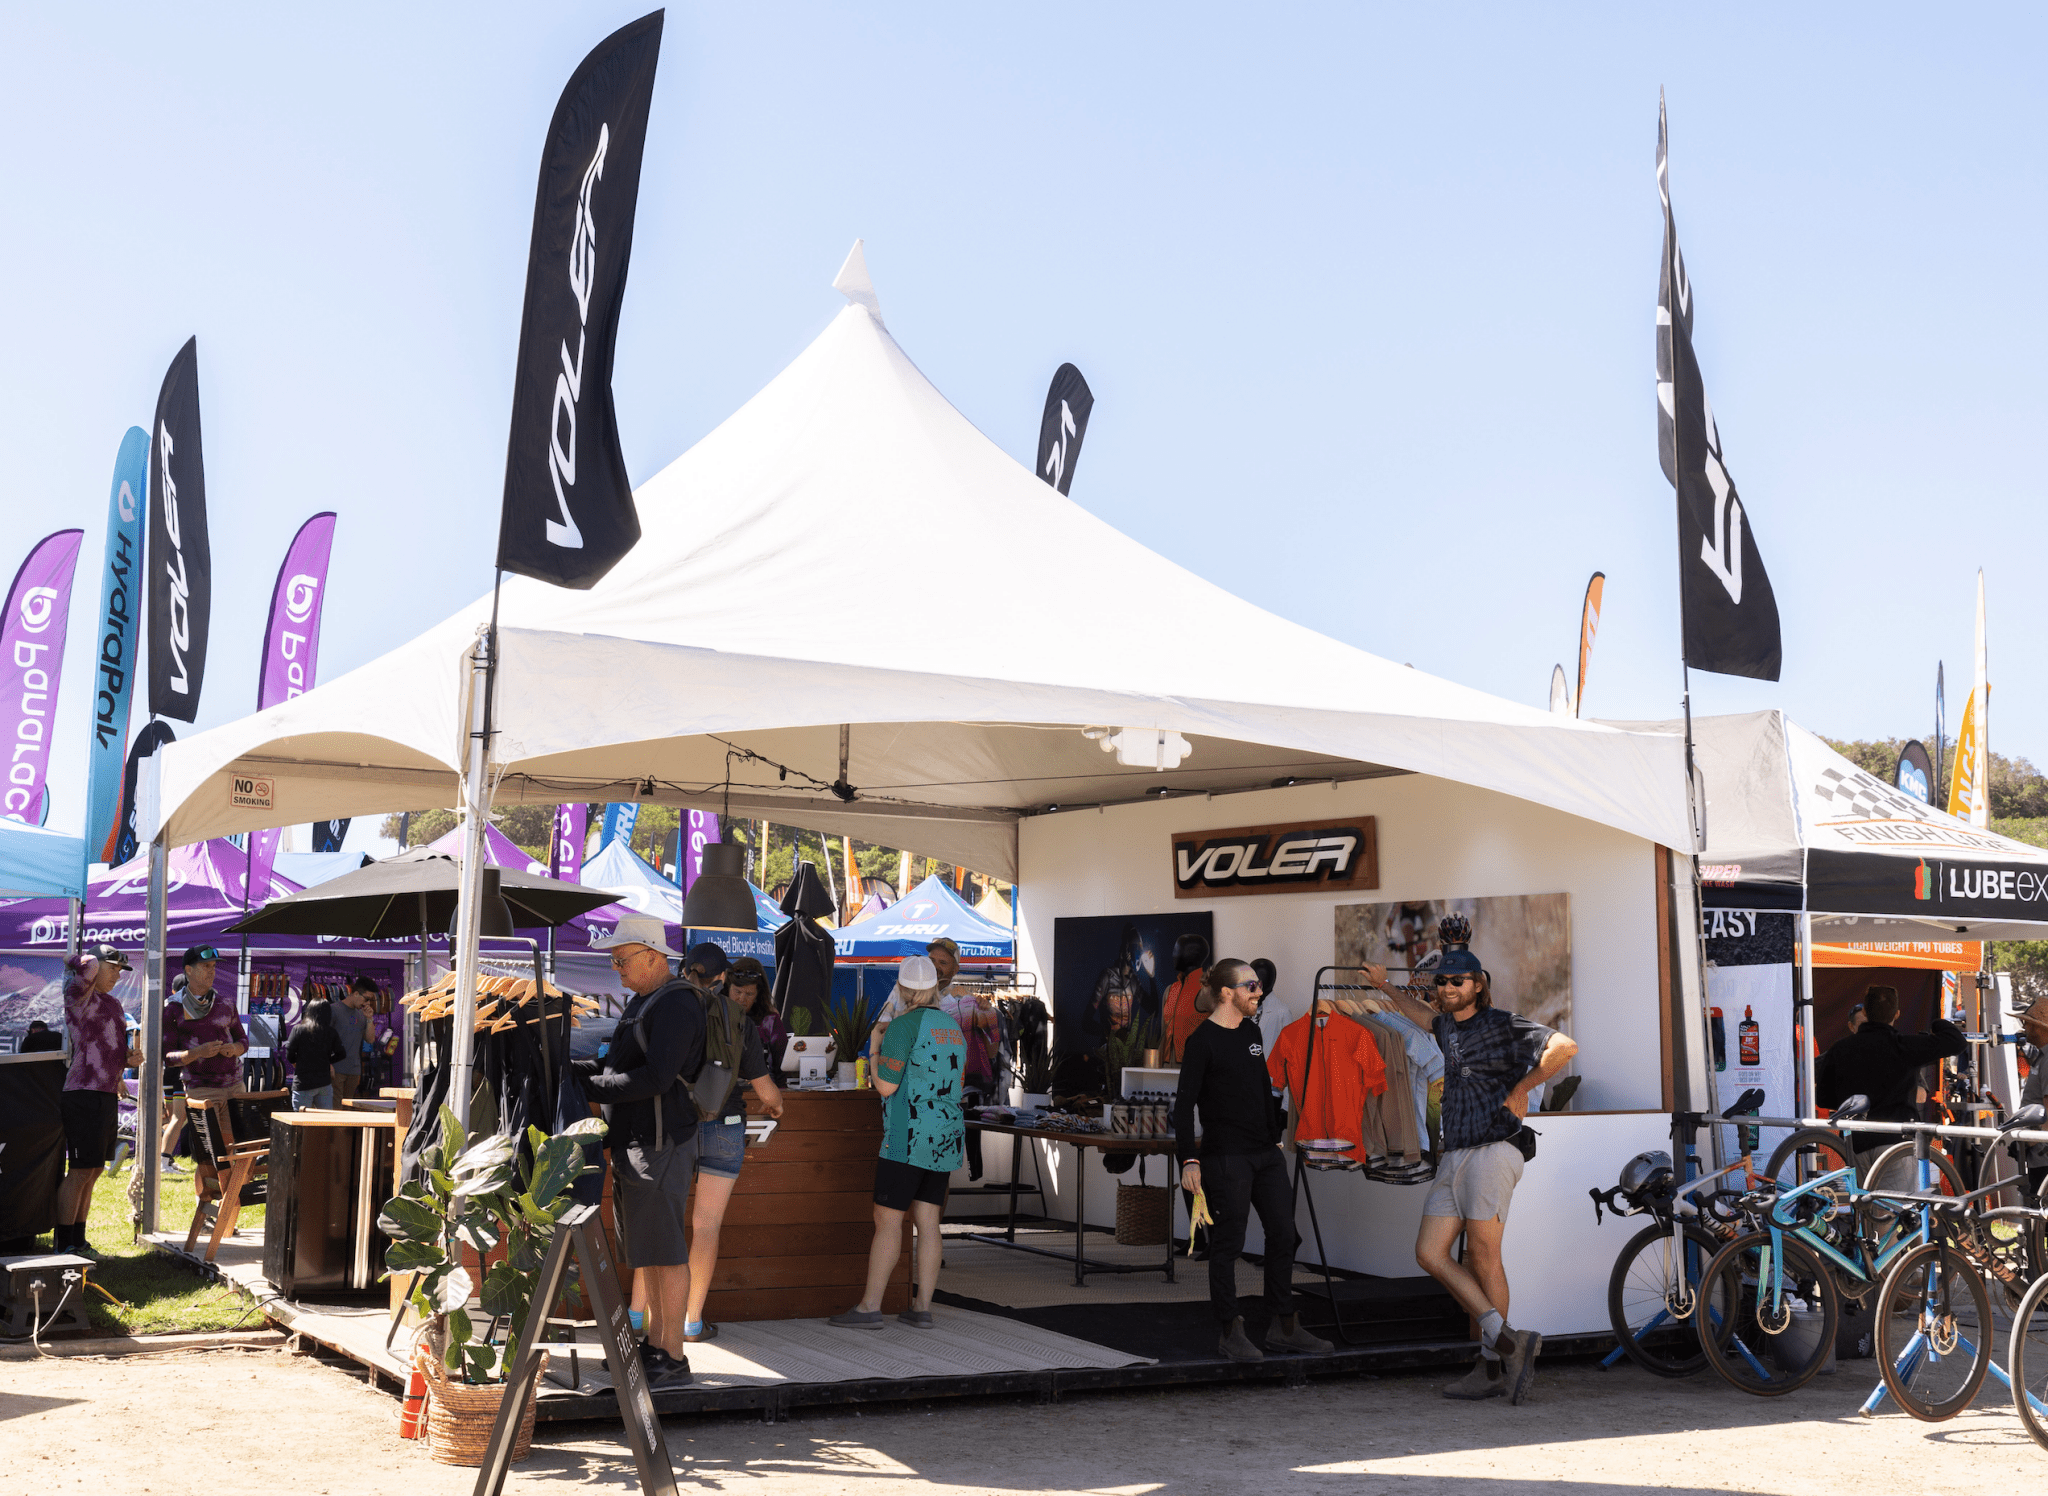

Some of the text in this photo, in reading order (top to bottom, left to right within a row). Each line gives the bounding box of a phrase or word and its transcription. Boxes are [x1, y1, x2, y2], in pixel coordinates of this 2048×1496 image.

[546, 122, 608, 549] VOLER
[160, 418, 190, 695] VOLER
[96, 530, 132, 751] HydraPak
[234, 779, 253, 793] NO
[1900, 768, 1928, 803] KMC
[233, 796, 271, 806] SMOKING
[1834, 825, 2017, 851] FINISH LINE
[1177, 835, 1358, 882] VOLER
[874, 923, 950, 935] THRU
[731, 935, 756, 957] Bicycle
[1912, 942, 1931, 953] TPU
[1934, 943, 1963, 954] TUBES
